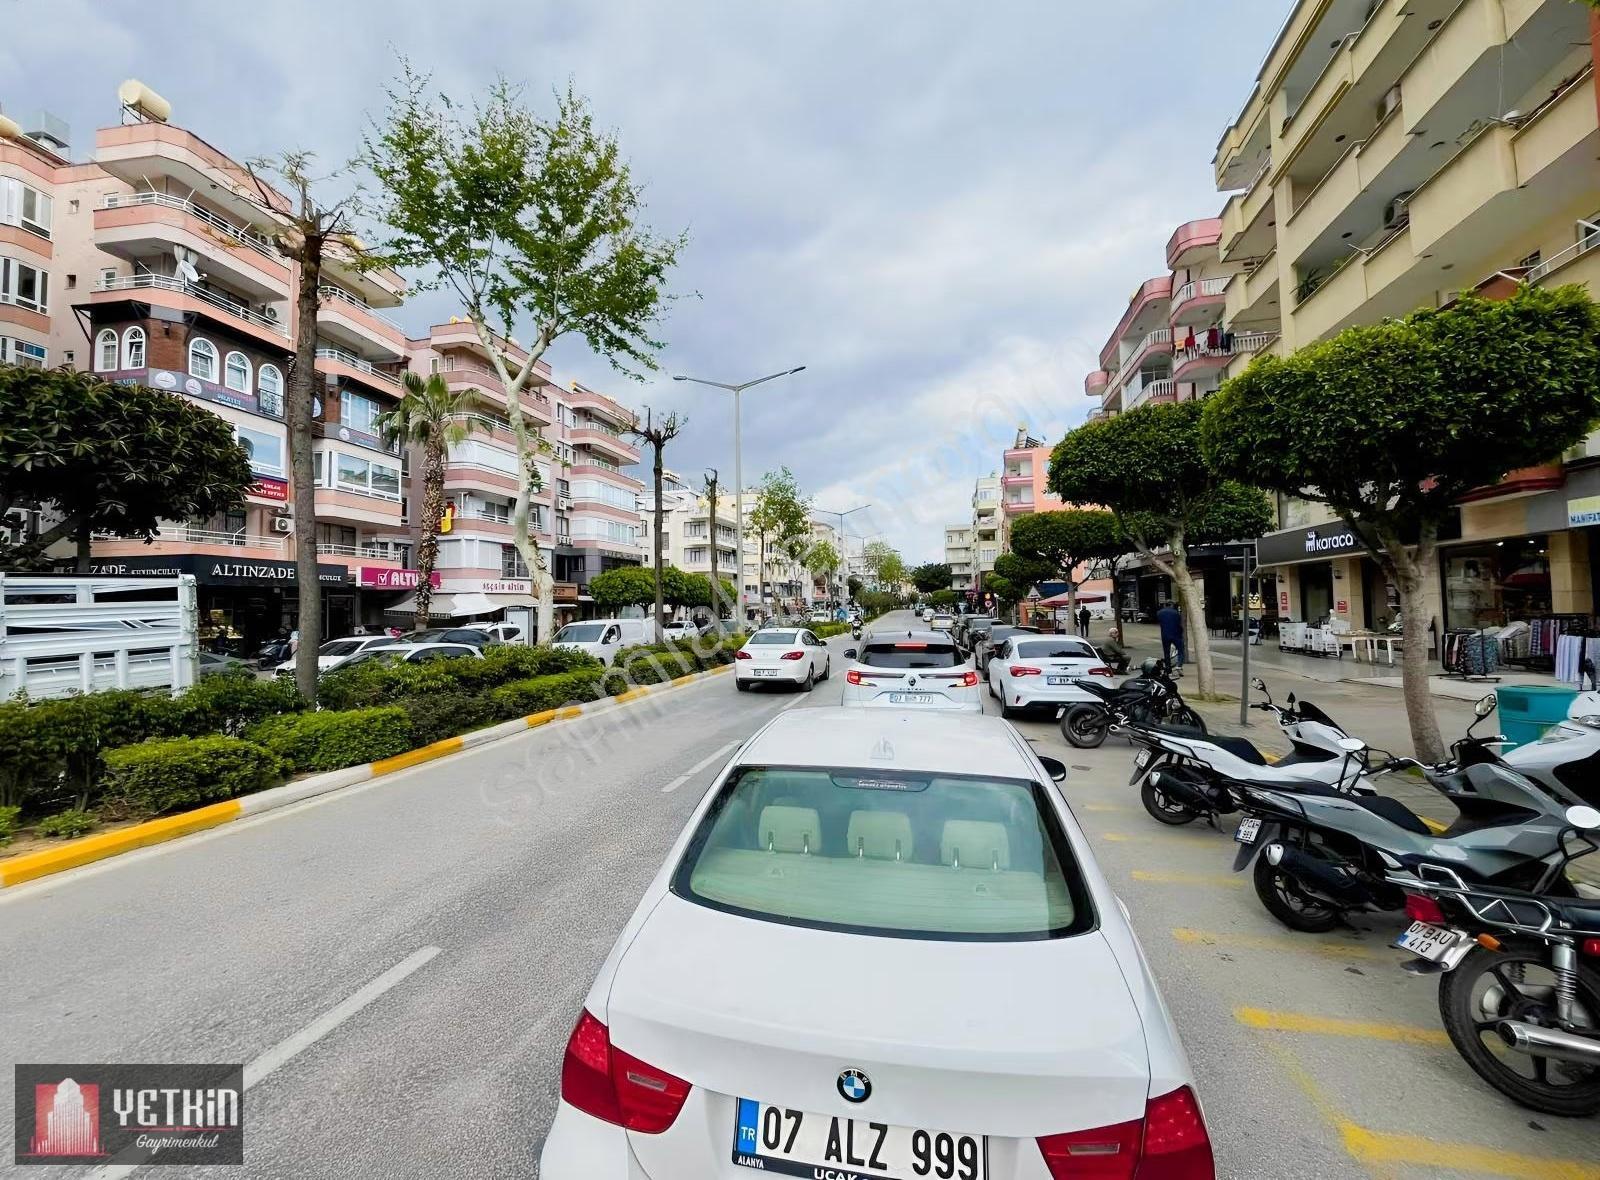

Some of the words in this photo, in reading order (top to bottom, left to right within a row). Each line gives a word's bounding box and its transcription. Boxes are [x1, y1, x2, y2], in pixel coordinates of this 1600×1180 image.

[1316, 533, 1354, 551] karaca
[212, 563, 295, 579] ALTINZADE
[391, 571, 420, 587] ALTU
[1409, 923, 1428, 935] 07
[1422, 927, 1453, 945] BAU
[1408, 937, 1432, 953] 413
[741, 1126, 756, 1141] TR
[762, 1106, 804, 1154] 07
[824, 1116, 889, 1171] ALZ
[911, 1129, 978, 1180] 999
[737, 1155, 766, 1170] ALANYA
